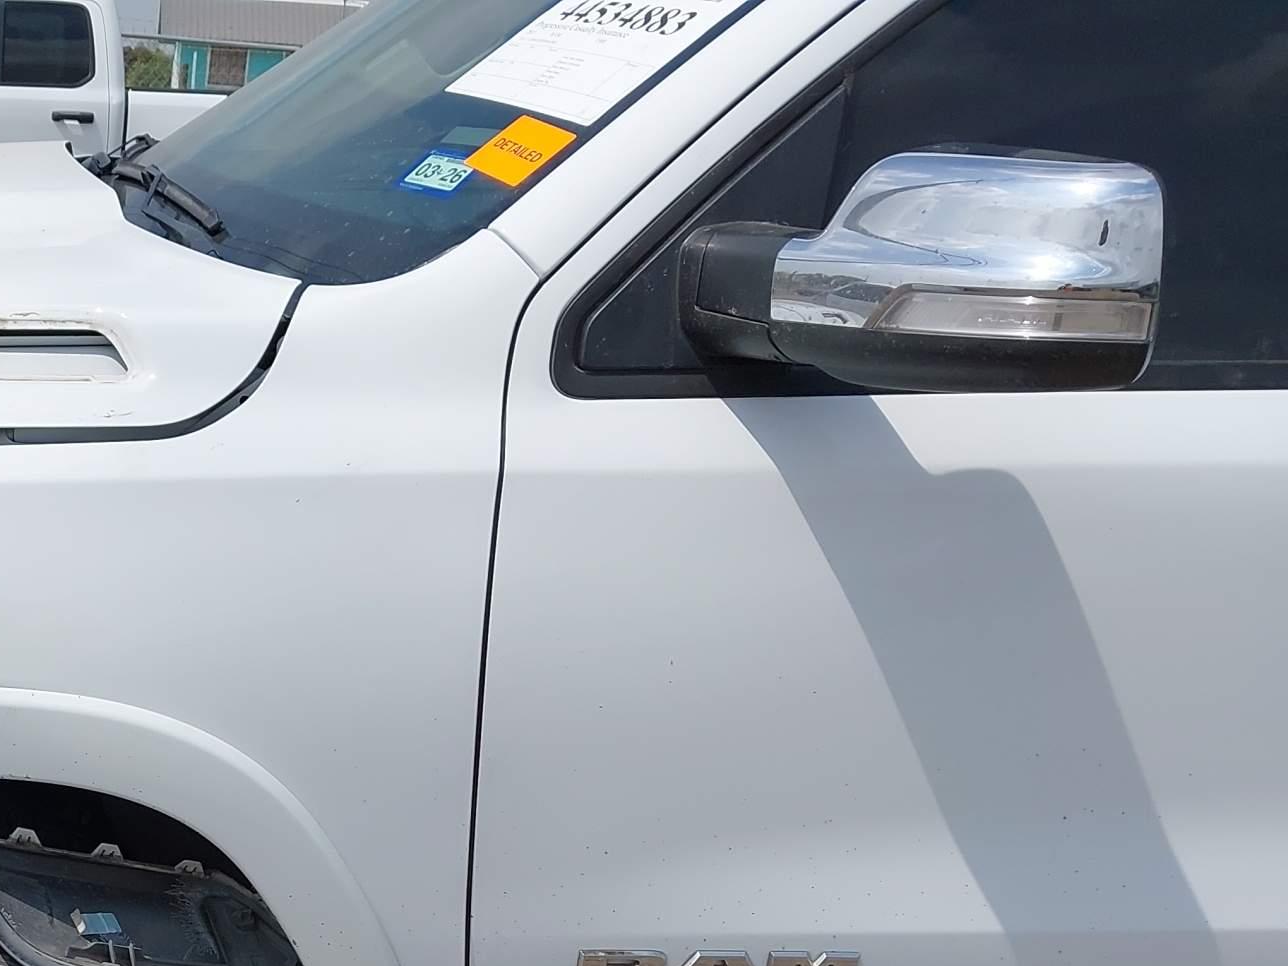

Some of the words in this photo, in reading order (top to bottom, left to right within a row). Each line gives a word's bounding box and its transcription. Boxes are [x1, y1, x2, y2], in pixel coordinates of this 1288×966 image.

[560, 0, 698, 35] 44534883
[493, 137, 543, 163] DETAILED
[414, 162, 441, 179] 03
[439, 167, 468, 184] 26
